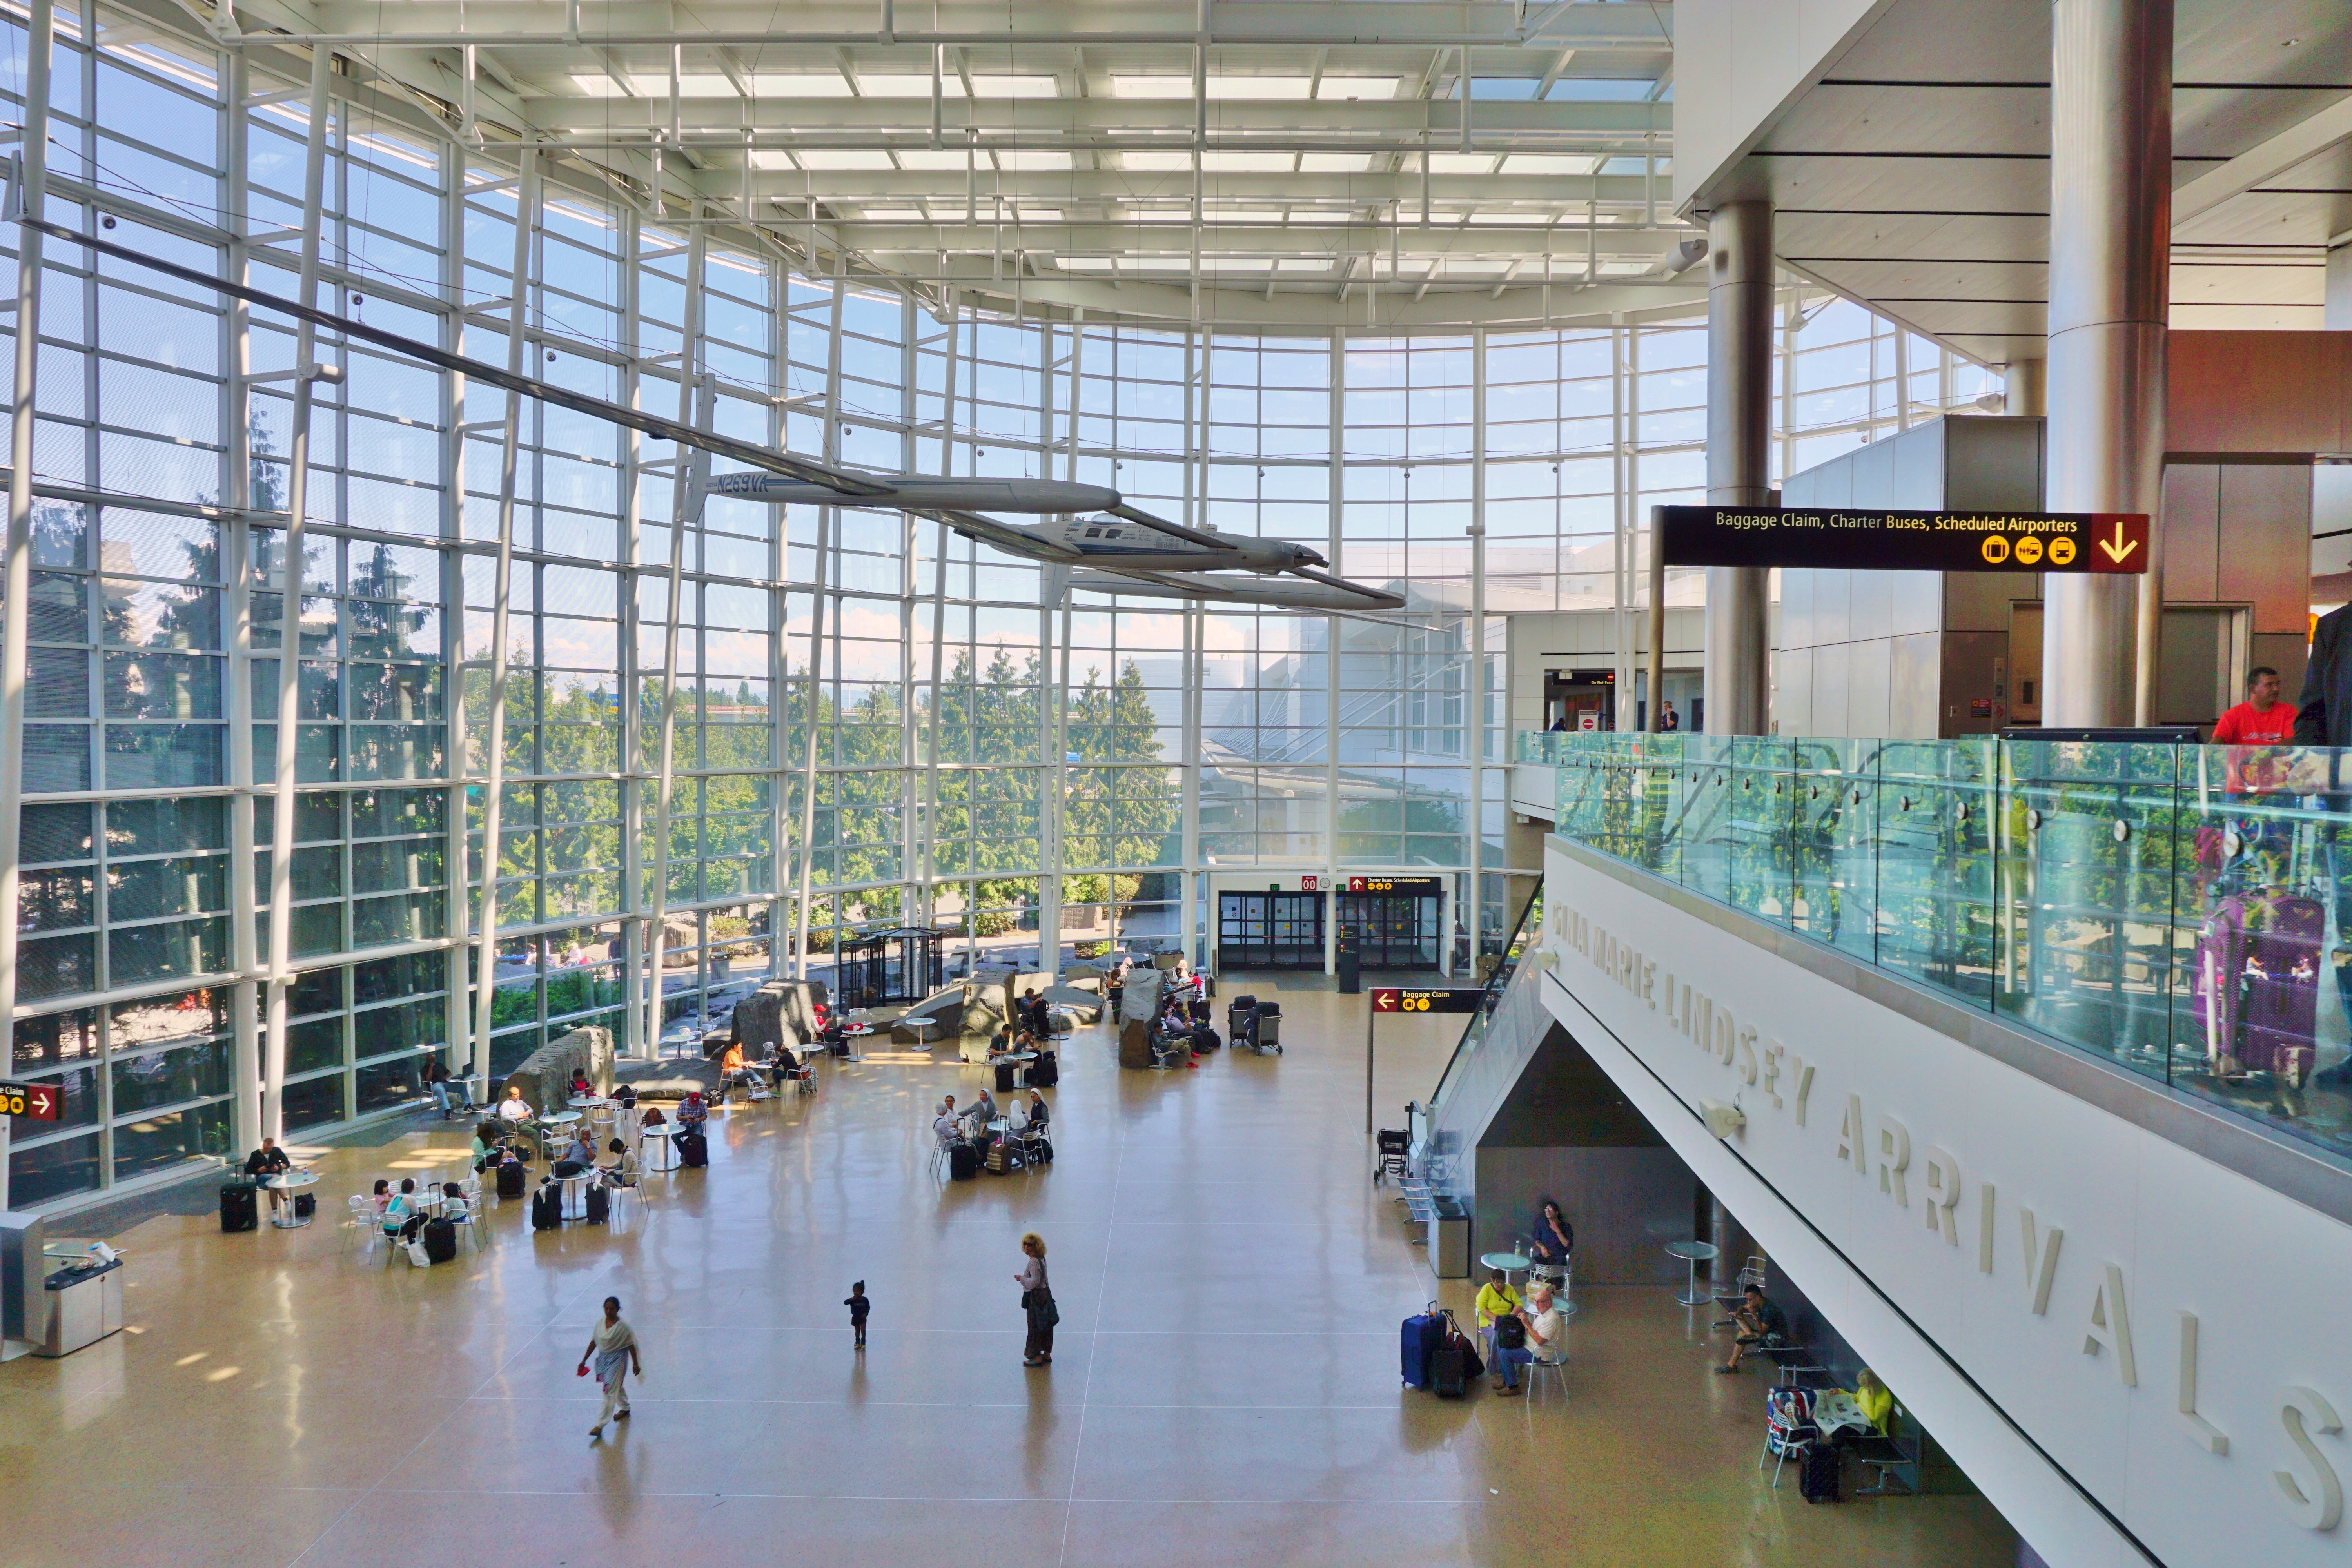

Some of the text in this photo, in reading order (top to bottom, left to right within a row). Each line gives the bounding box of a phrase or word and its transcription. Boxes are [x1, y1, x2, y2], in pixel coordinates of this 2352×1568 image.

[718, 475, 768, 493] N269VA
[1716, 512, 2077, 535] Baggage Claim, Charter Buses, Scheduled Airporters
[1303, 880, 1316, 889] 00
[5, 1086, 24, 1096] Claim
[1552, 900, 2343, 1531] GINA MARIE LINDSEY ARRIVALS
